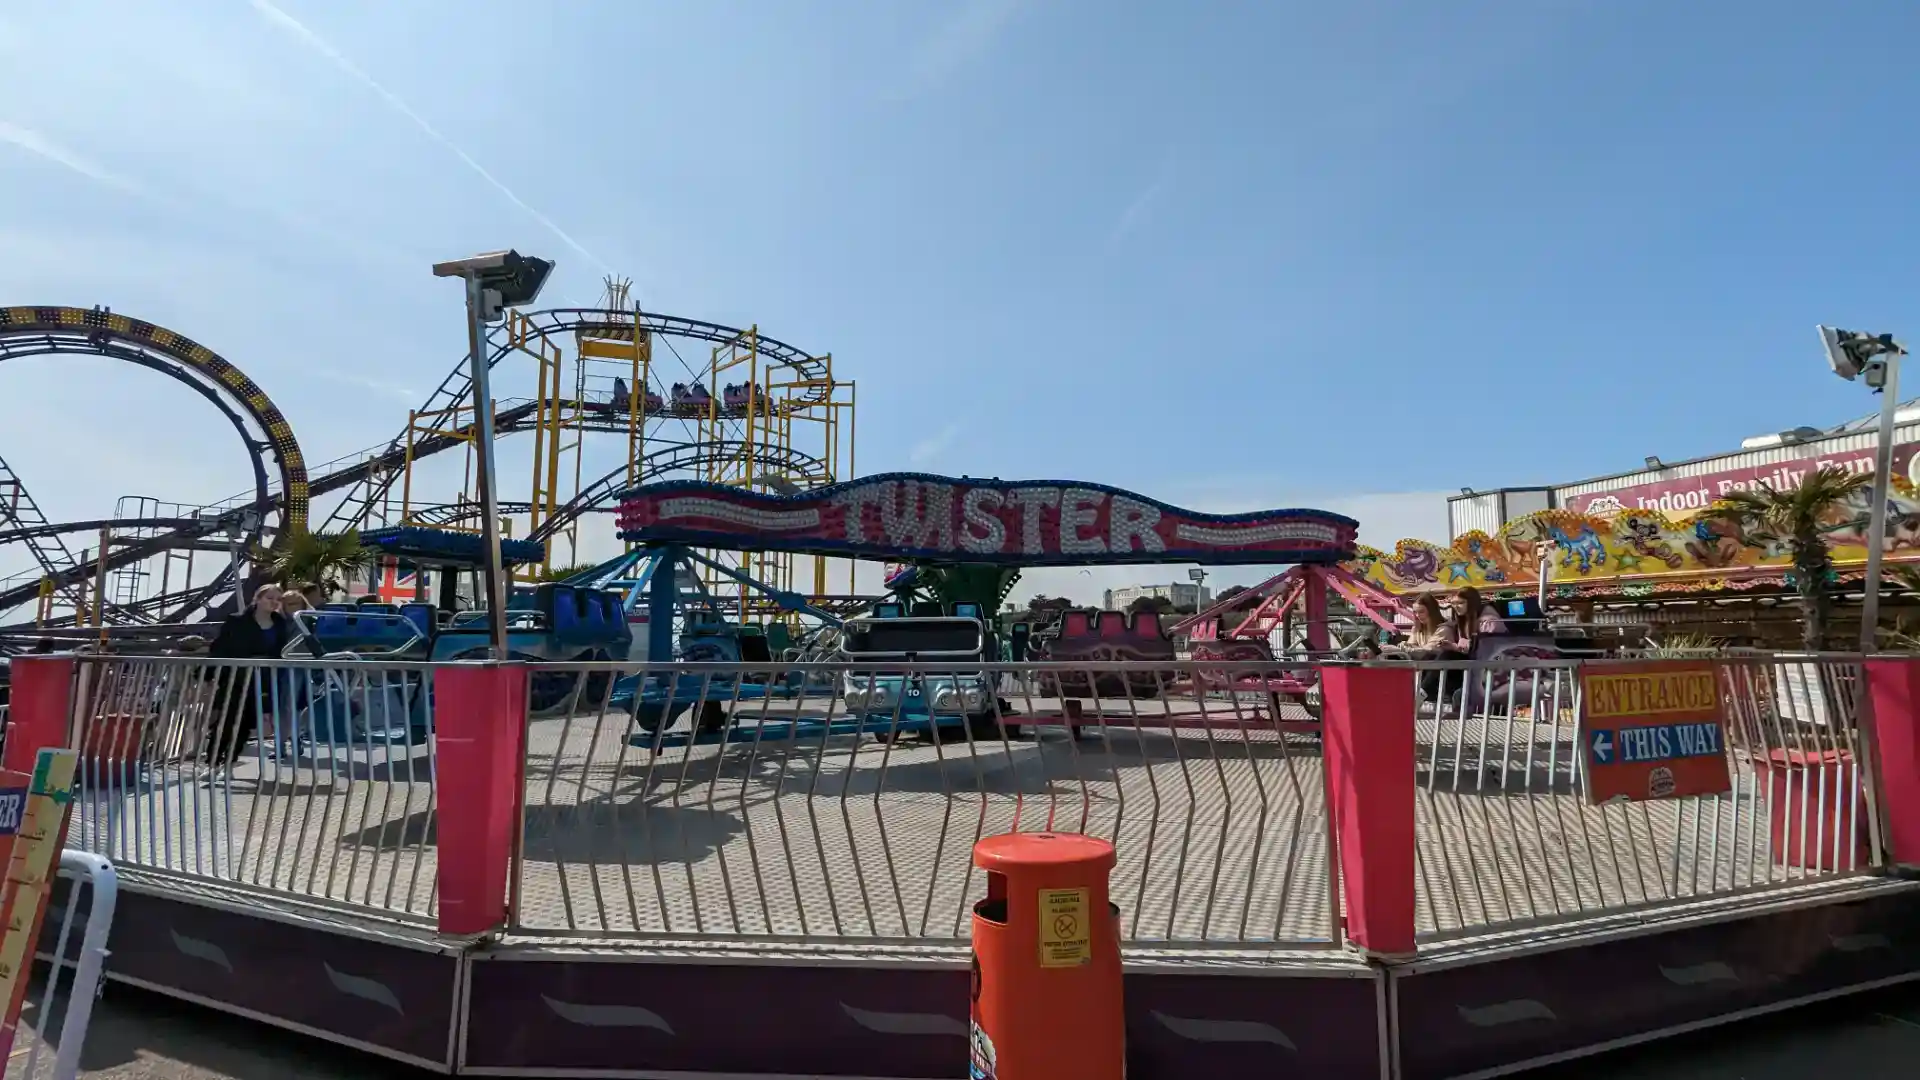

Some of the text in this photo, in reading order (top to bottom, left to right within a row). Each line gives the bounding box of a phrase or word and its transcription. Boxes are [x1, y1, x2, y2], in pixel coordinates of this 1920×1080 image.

[1636, 489, 1709, 513] Indoor
[1717, 467, 1807, 497] Family
[829, 480, 1166, 554] TWISTER
[1591, 675, 1714, 713] ENTRANCE
[1620, 723, 1718, 761] THIS WAY
